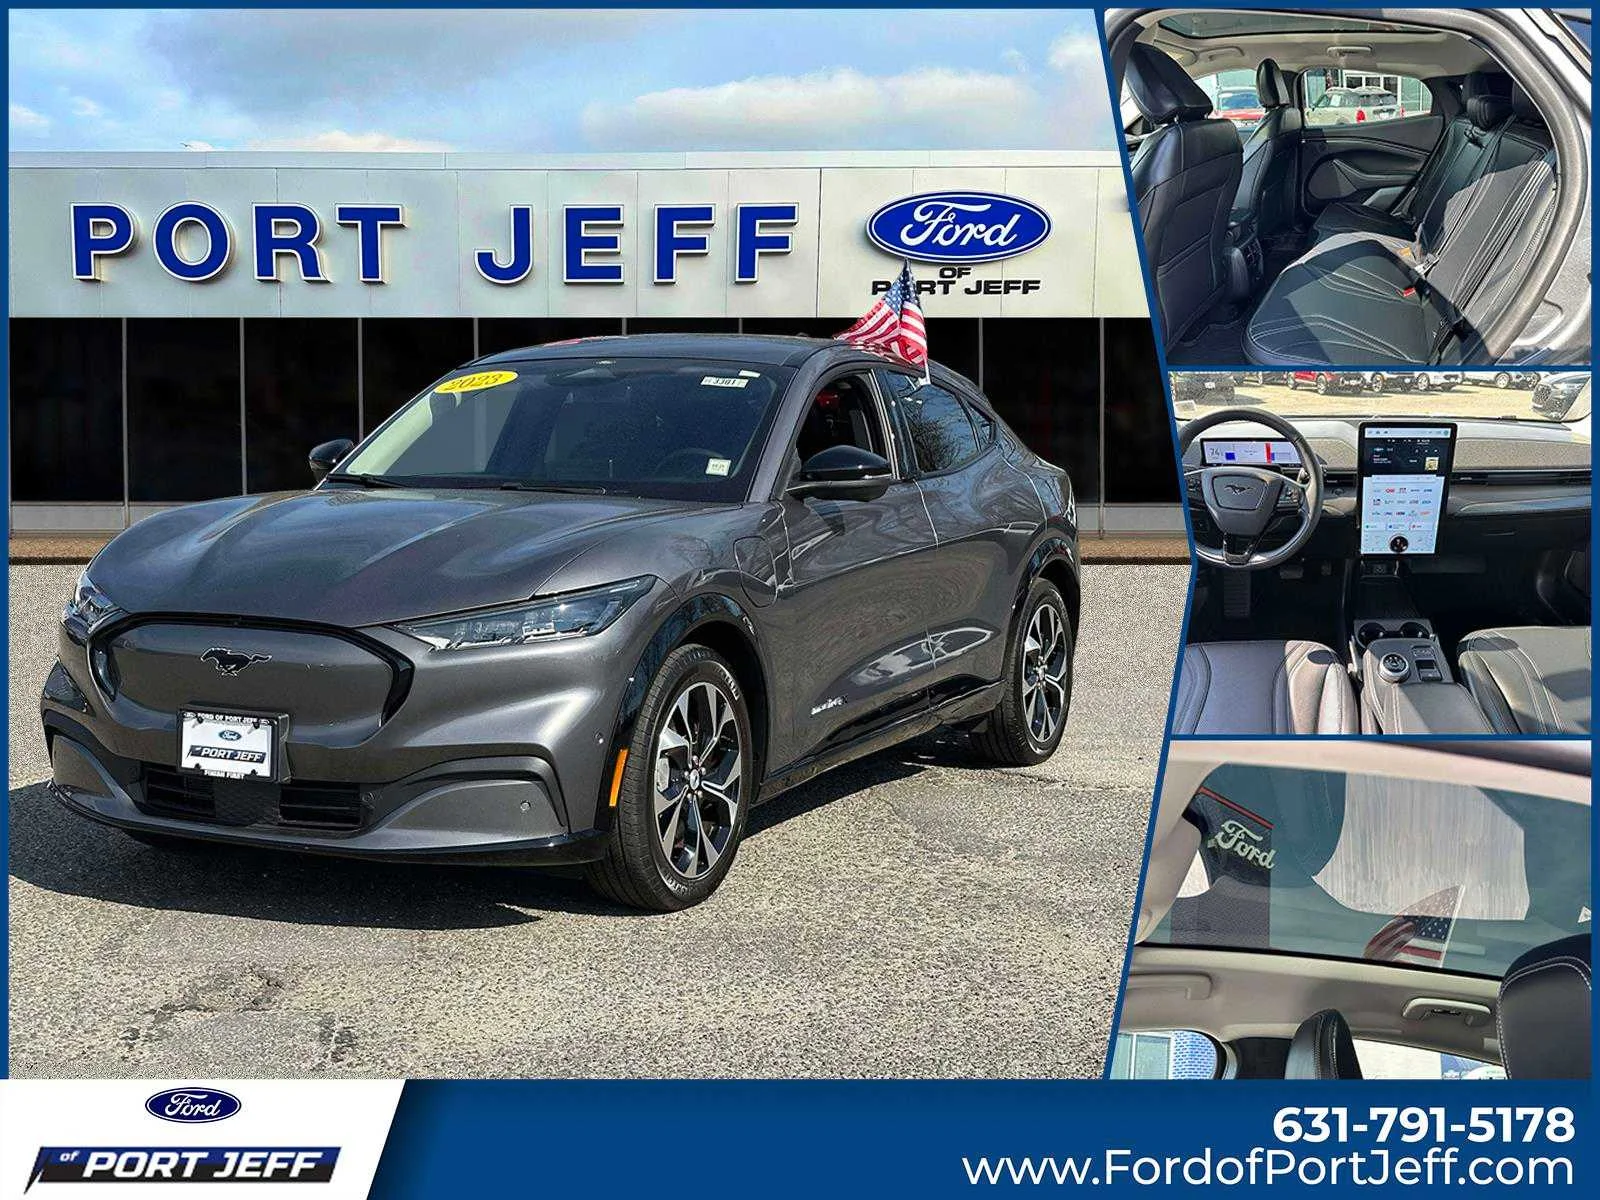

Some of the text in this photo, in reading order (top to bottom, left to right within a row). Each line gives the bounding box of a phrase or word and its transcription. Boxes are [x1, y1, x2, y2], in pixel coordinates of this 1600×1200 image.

[900, 201, 1021, 247] Ford
[69, 202, 799, 285] PORT JEFF
[939, 267, 971, 278] OF
[872, 280, 1041, 295] PRT JEFF
[443, 374, 503, 391] 2023
[201, 747, 233, 759] PORT
[234, 751, 262, 761] JEFF
[1214, 820, 1276, 869] Ford
